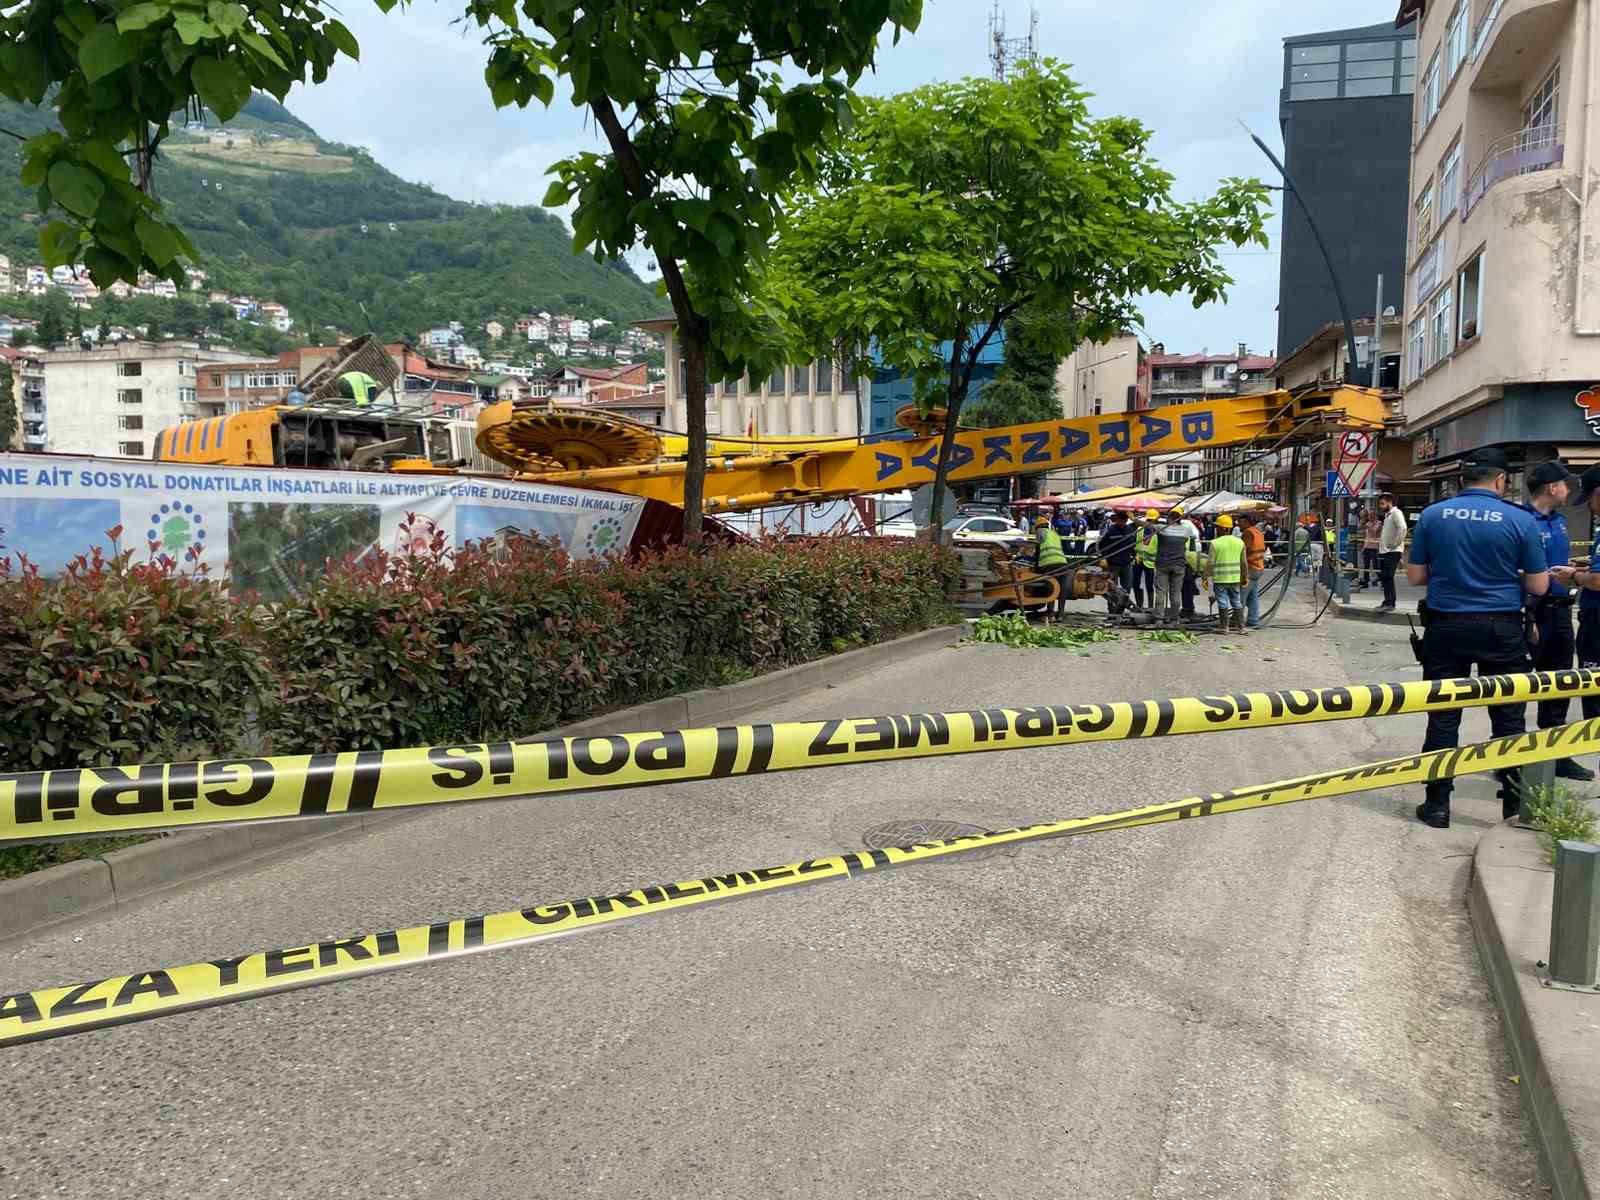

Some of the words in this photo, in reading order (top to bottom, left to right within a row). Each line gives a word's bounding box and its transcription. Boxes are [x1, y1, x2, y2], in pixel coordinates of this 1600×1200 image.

[36, 466, 73, 487] AİT
[80, 471, 159, 489] SOSYAL
[165, 474, 262, 492] DONATILAR
[267, 476, 351, 496] İNŞAATLARI
[356, 479, 376, 495] İLE
[380, 483, 430, 497] ALTYAPI
[492, 486, 579, 508] DÜZENLEMESİ
[581, 494, 616, 511] İKMAL
[1442, 507, 1503, 523] POLİS
[428, 730, 686, 789] POLİS
